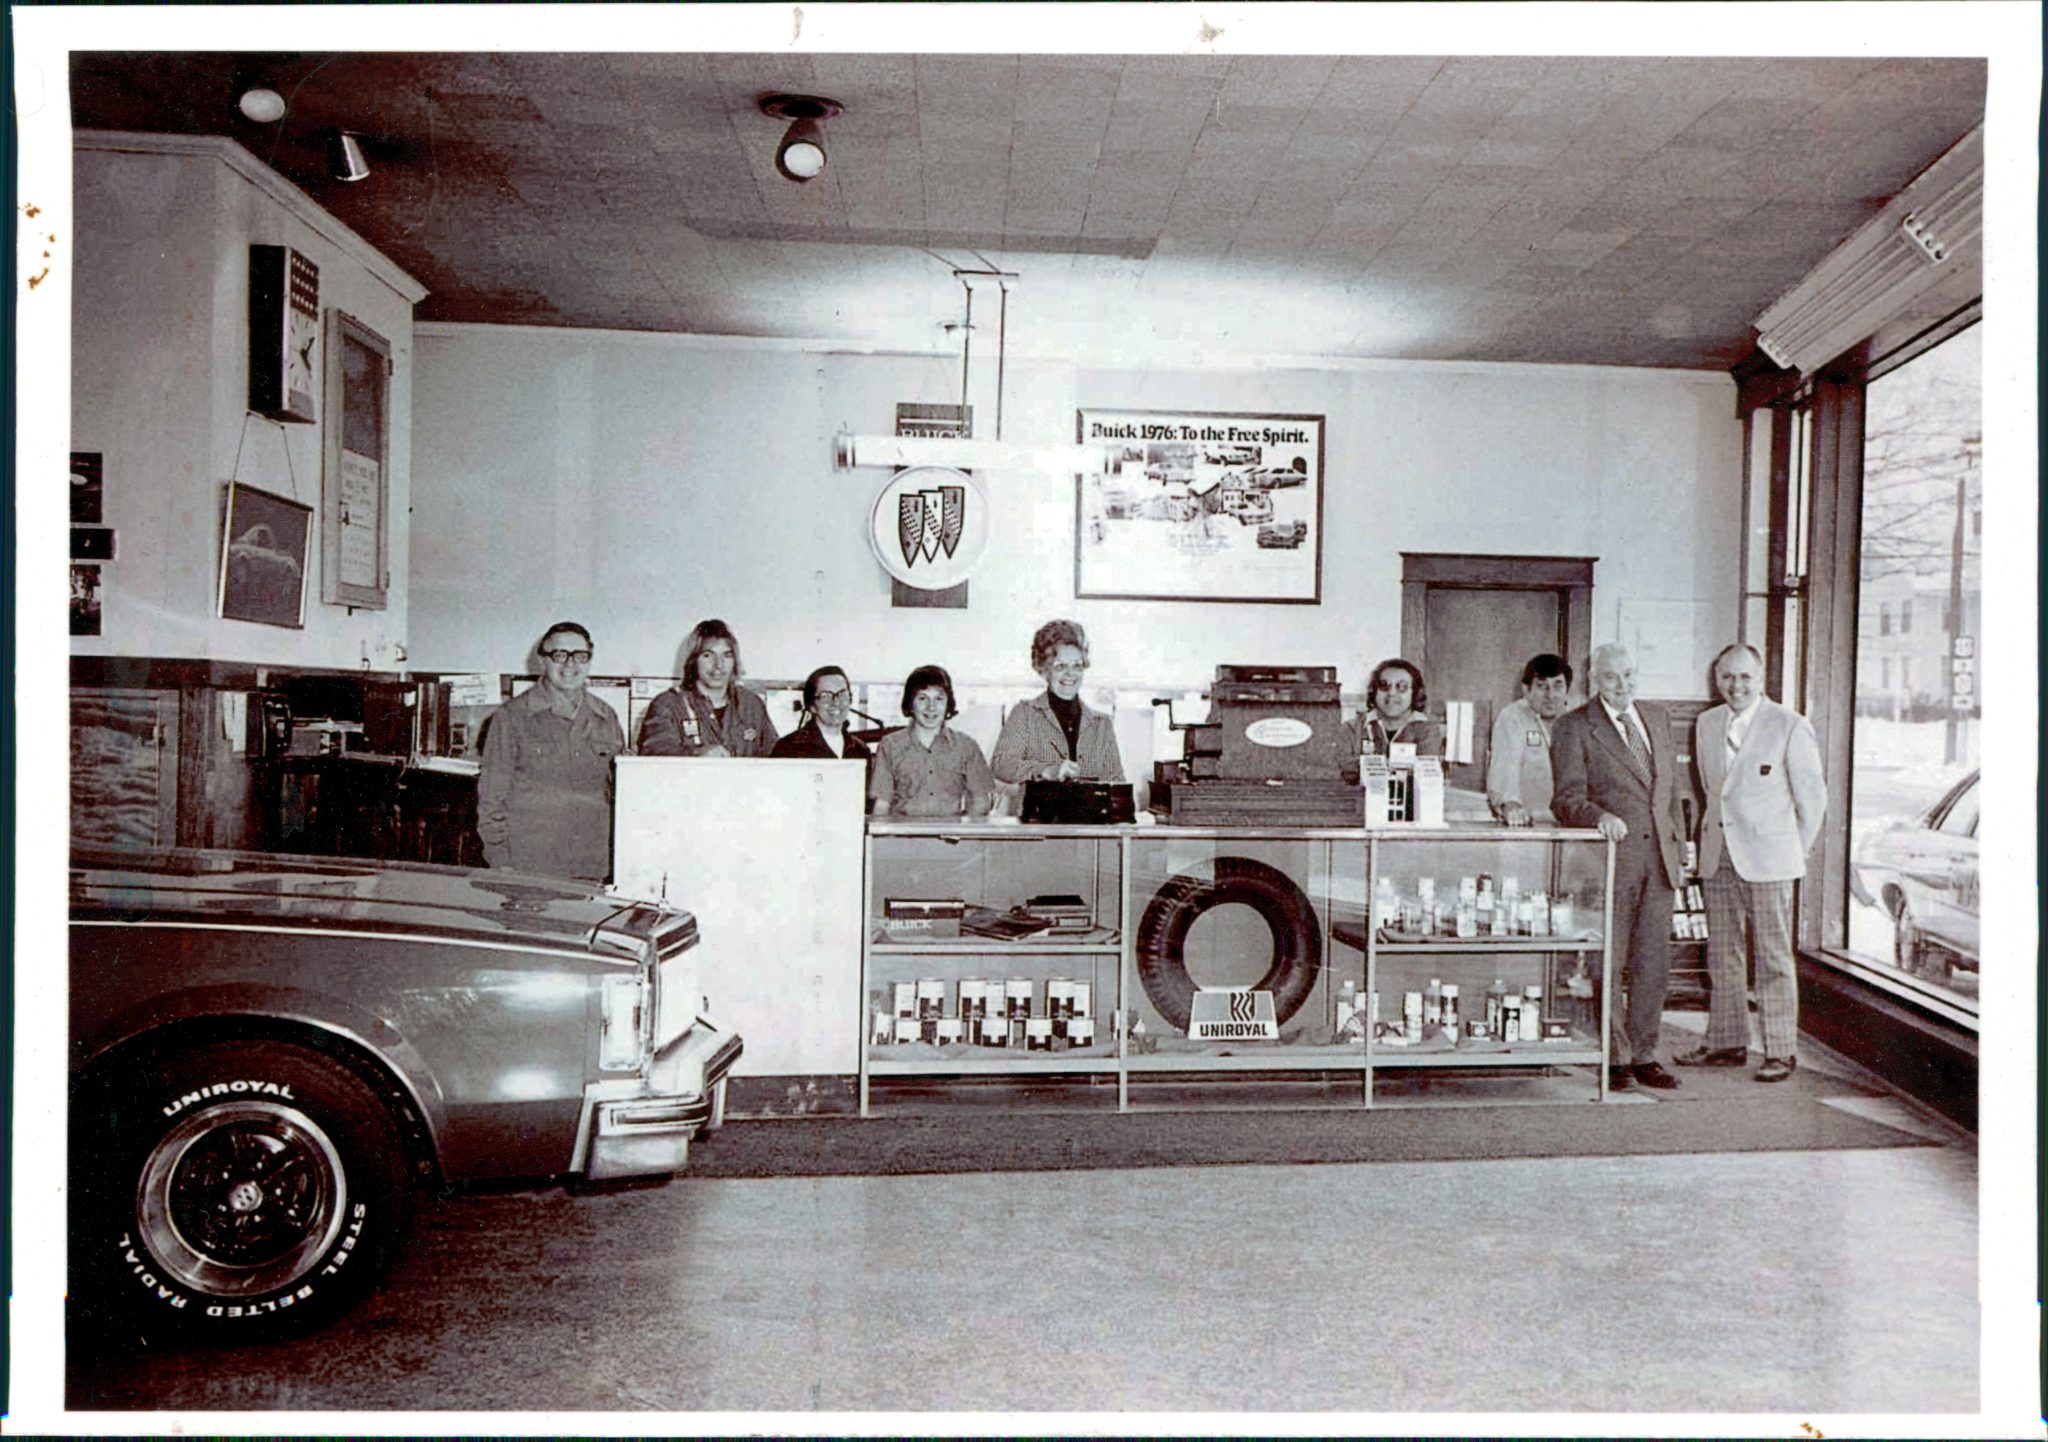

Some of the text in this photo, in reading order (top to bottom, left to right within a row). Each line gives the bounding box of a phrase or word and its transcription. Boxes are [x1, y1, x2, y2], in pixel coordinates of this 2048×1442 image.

[1092, 423, 1309, 446] Buick 1976: To the Free Spirit.
[890, 919, 932, 930] BUICK
[1200, 1023, 1268, 1037] UNIROYAL
[162, 1080, 295, 1117] UNIROYAL
[118, 1203, 366, 1317] STEEL BELTED RADIAL
